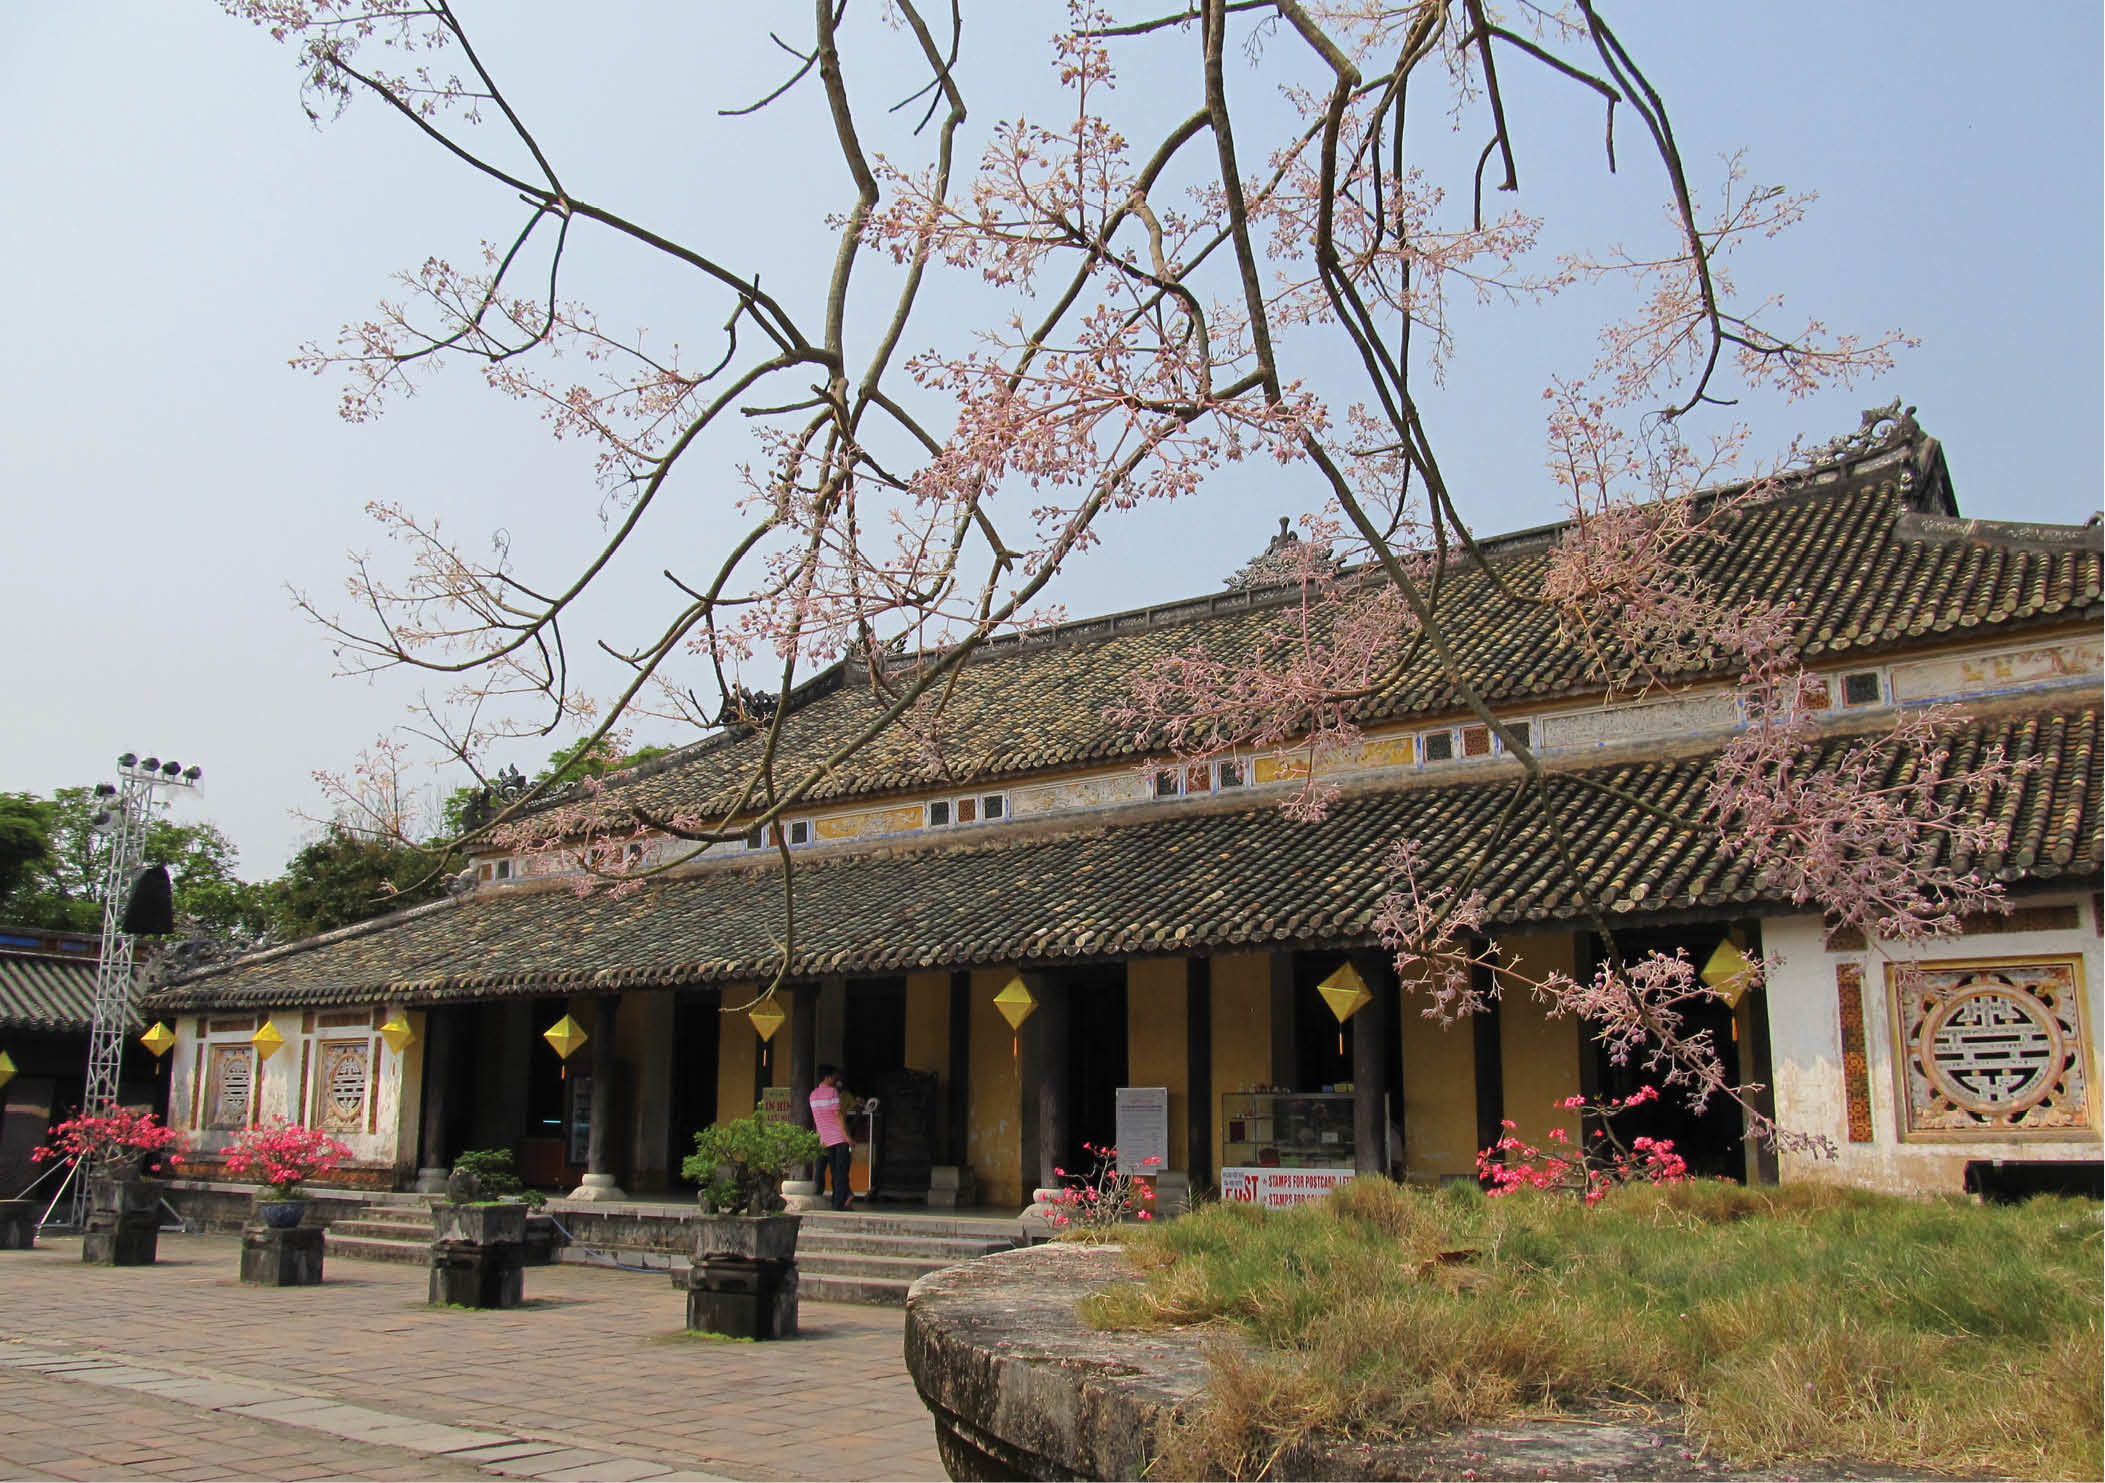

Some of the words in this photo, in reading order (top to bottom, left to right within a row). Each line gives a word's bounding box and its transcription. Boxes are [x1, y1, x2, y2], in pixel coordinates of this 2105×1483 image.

[1268, 1175, 1292, 1188] STAMPS
[1293, 1175, 1304, 1188] FOR
[1268, 1193, 1292, 1206] STAMPS
